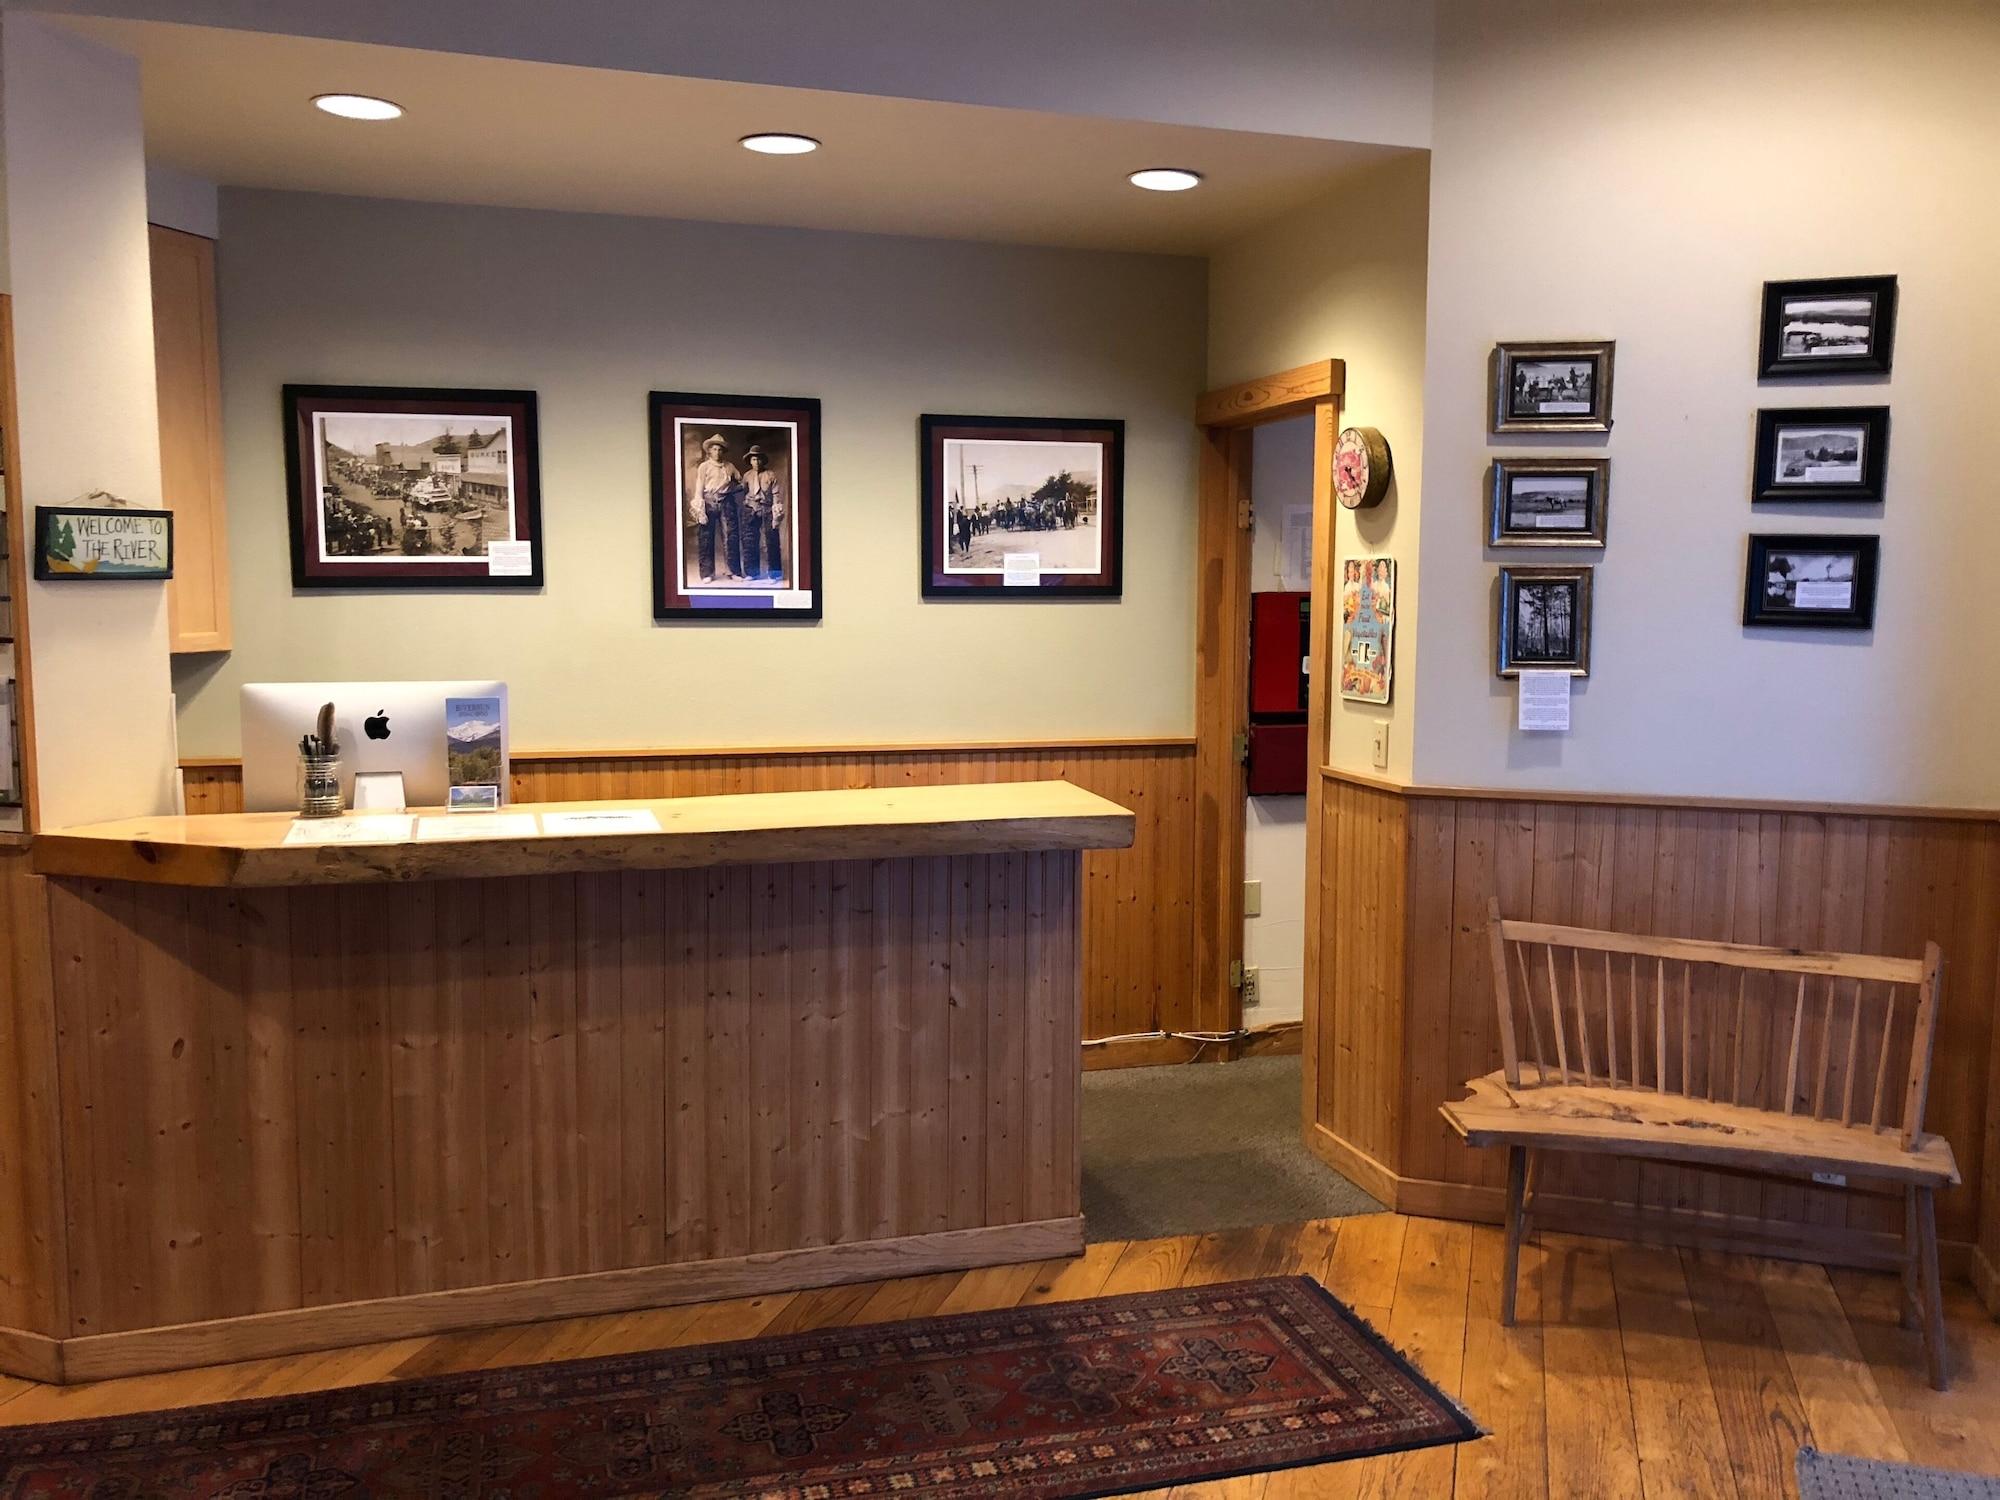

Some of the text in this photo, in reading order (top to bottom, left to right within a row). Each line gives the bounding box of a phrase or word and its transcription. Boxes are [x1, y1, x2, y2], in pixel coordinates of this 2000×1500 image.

[77, 516, 163, 537] WELCOME TO
[82, 538, 161, 561] THE RIVER
